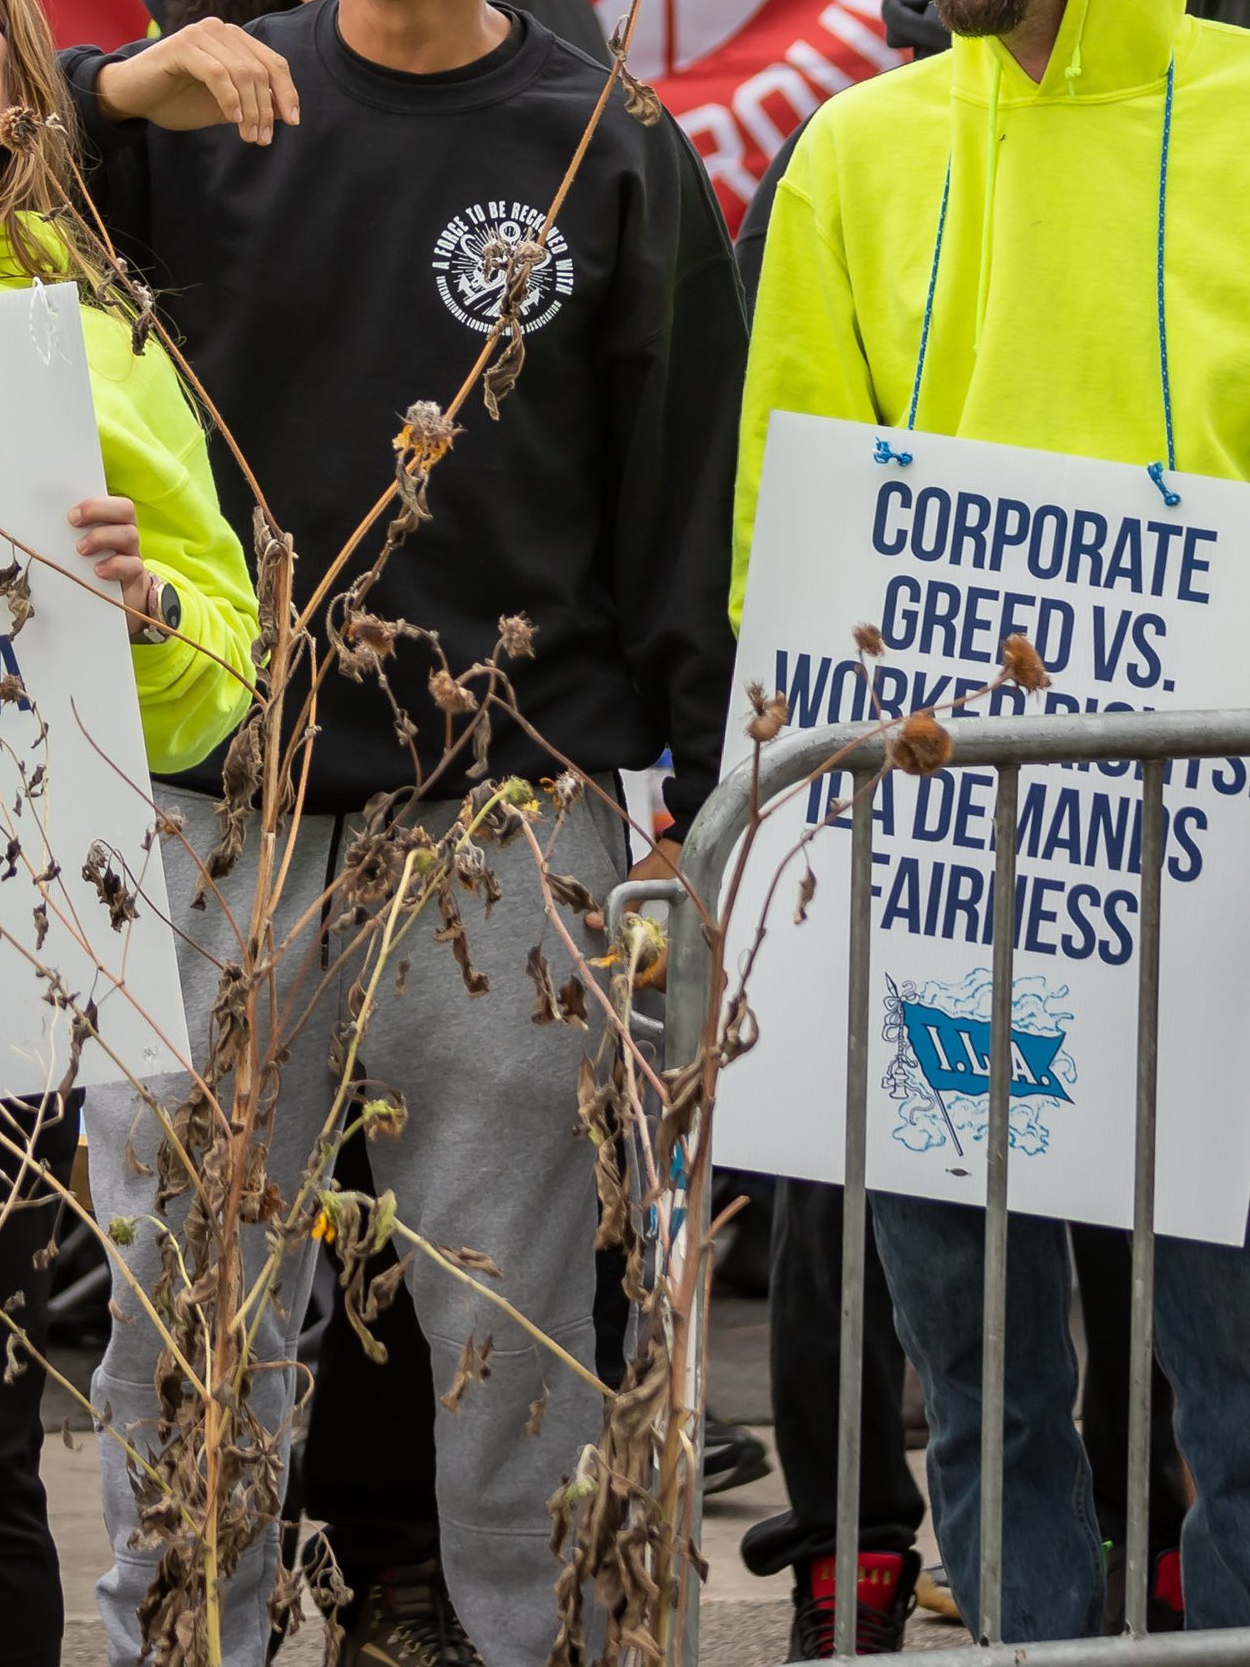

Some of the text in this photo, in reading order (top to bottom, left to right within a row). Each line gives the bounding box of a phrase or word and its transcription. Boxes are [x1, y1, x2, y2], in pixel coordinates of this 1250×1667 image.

[431, 200, 574, 296] A FORCE TO BE RECKNED WITH
[872, 480, 1218, 605] CORPORATE
[1092, 605, 1176, 693] VS.
